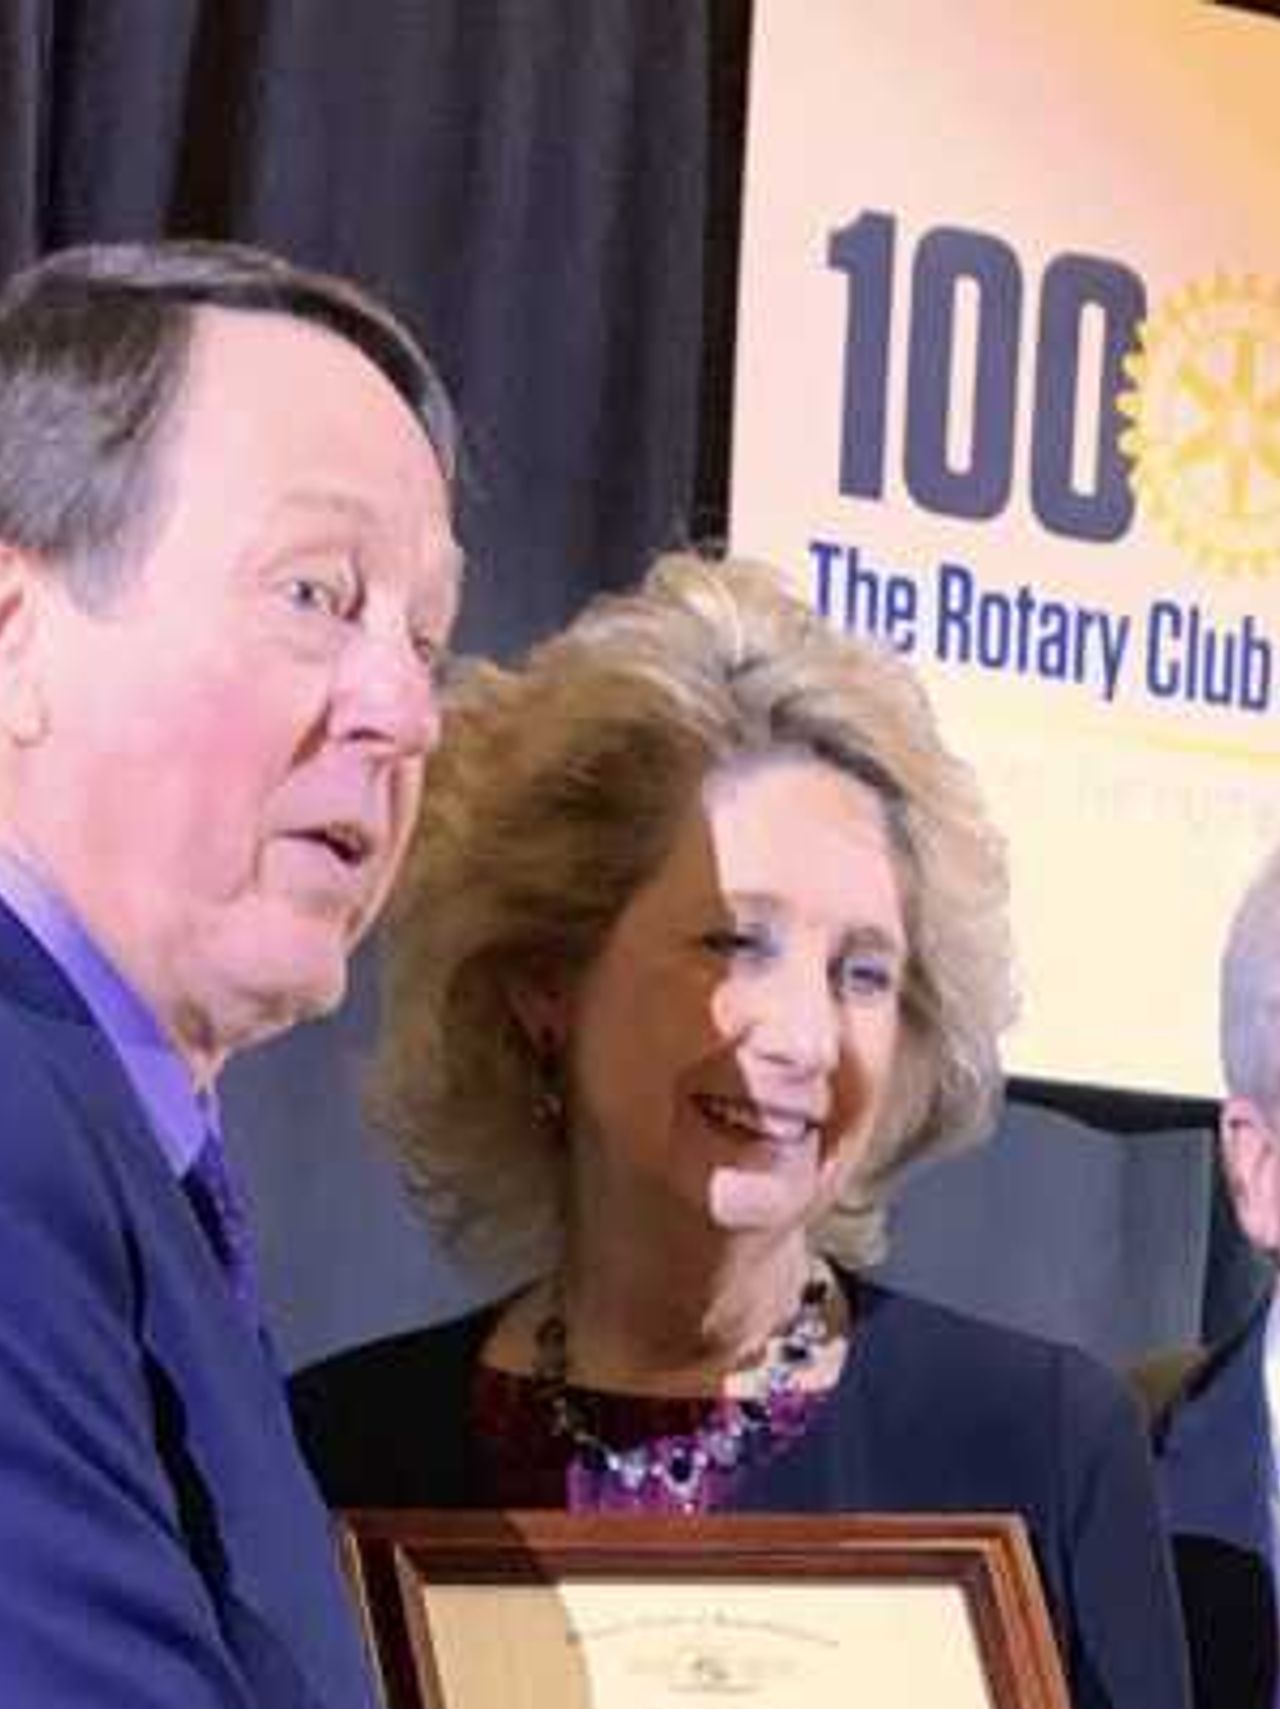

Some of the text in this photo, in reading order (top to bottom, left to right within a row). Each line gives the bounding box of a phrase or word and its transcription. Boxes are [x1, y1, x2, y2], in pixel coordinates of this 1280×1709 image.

[827, 208, 1148, 544] 100
[808, 540, 918, 655] The
[935, 563, 1130, 702] Rotary
[1146, 599, 1272, 712] Club
